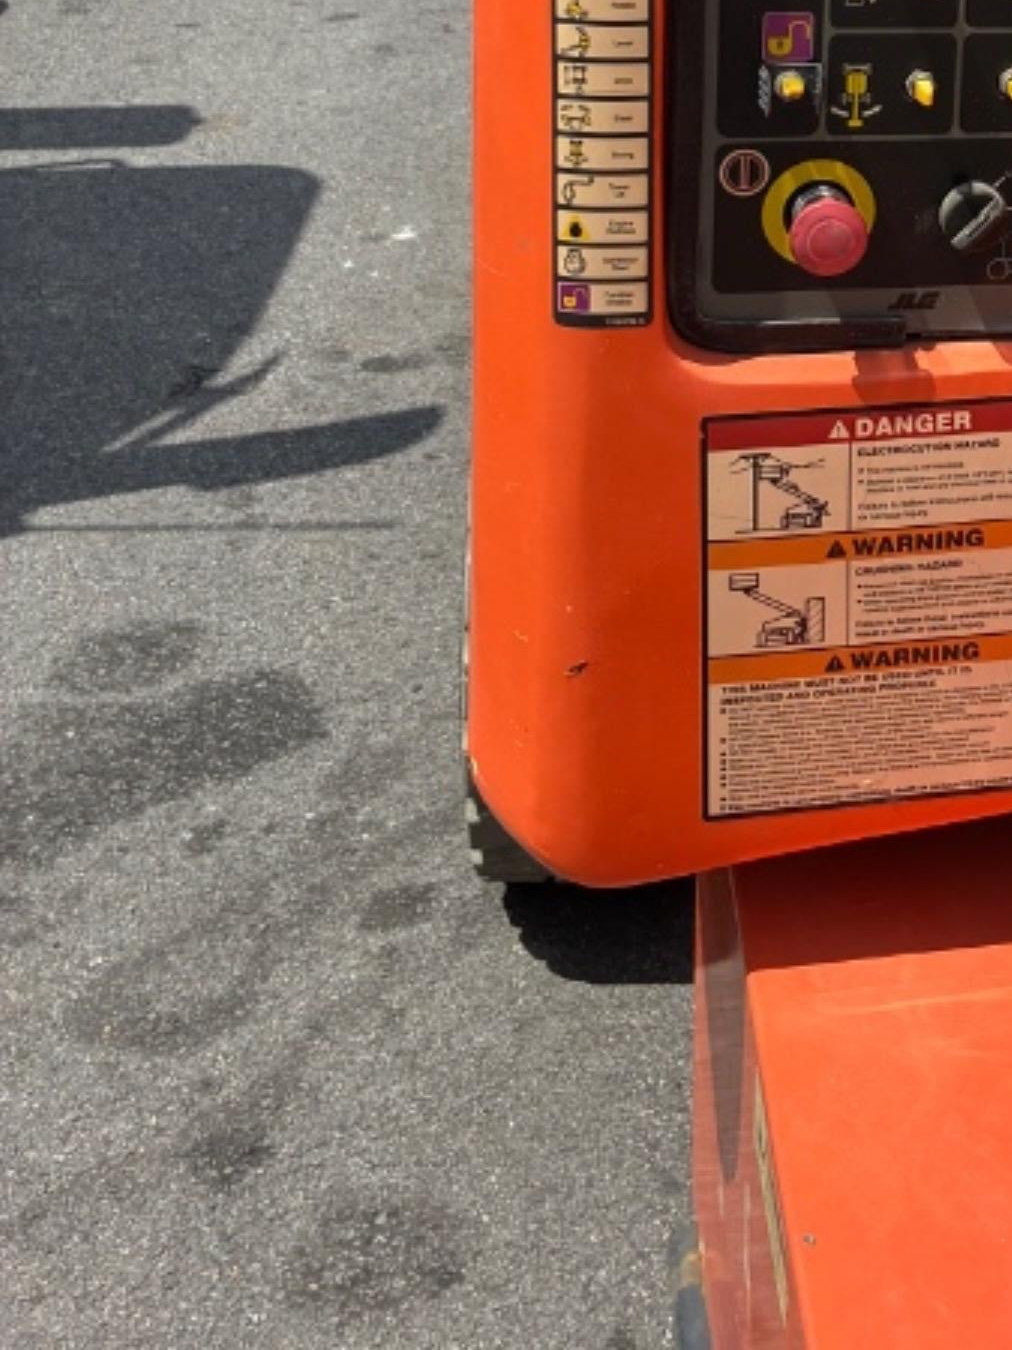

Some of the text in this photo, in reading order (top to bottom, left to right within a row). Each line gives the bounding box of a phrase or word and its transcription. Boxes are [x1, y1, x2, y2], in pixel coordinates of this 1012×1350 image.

[854, 410, 973, 438] DANGER
[852, 529, 985, 556] WARNING
[851, 641, 981, 670] WARNING
